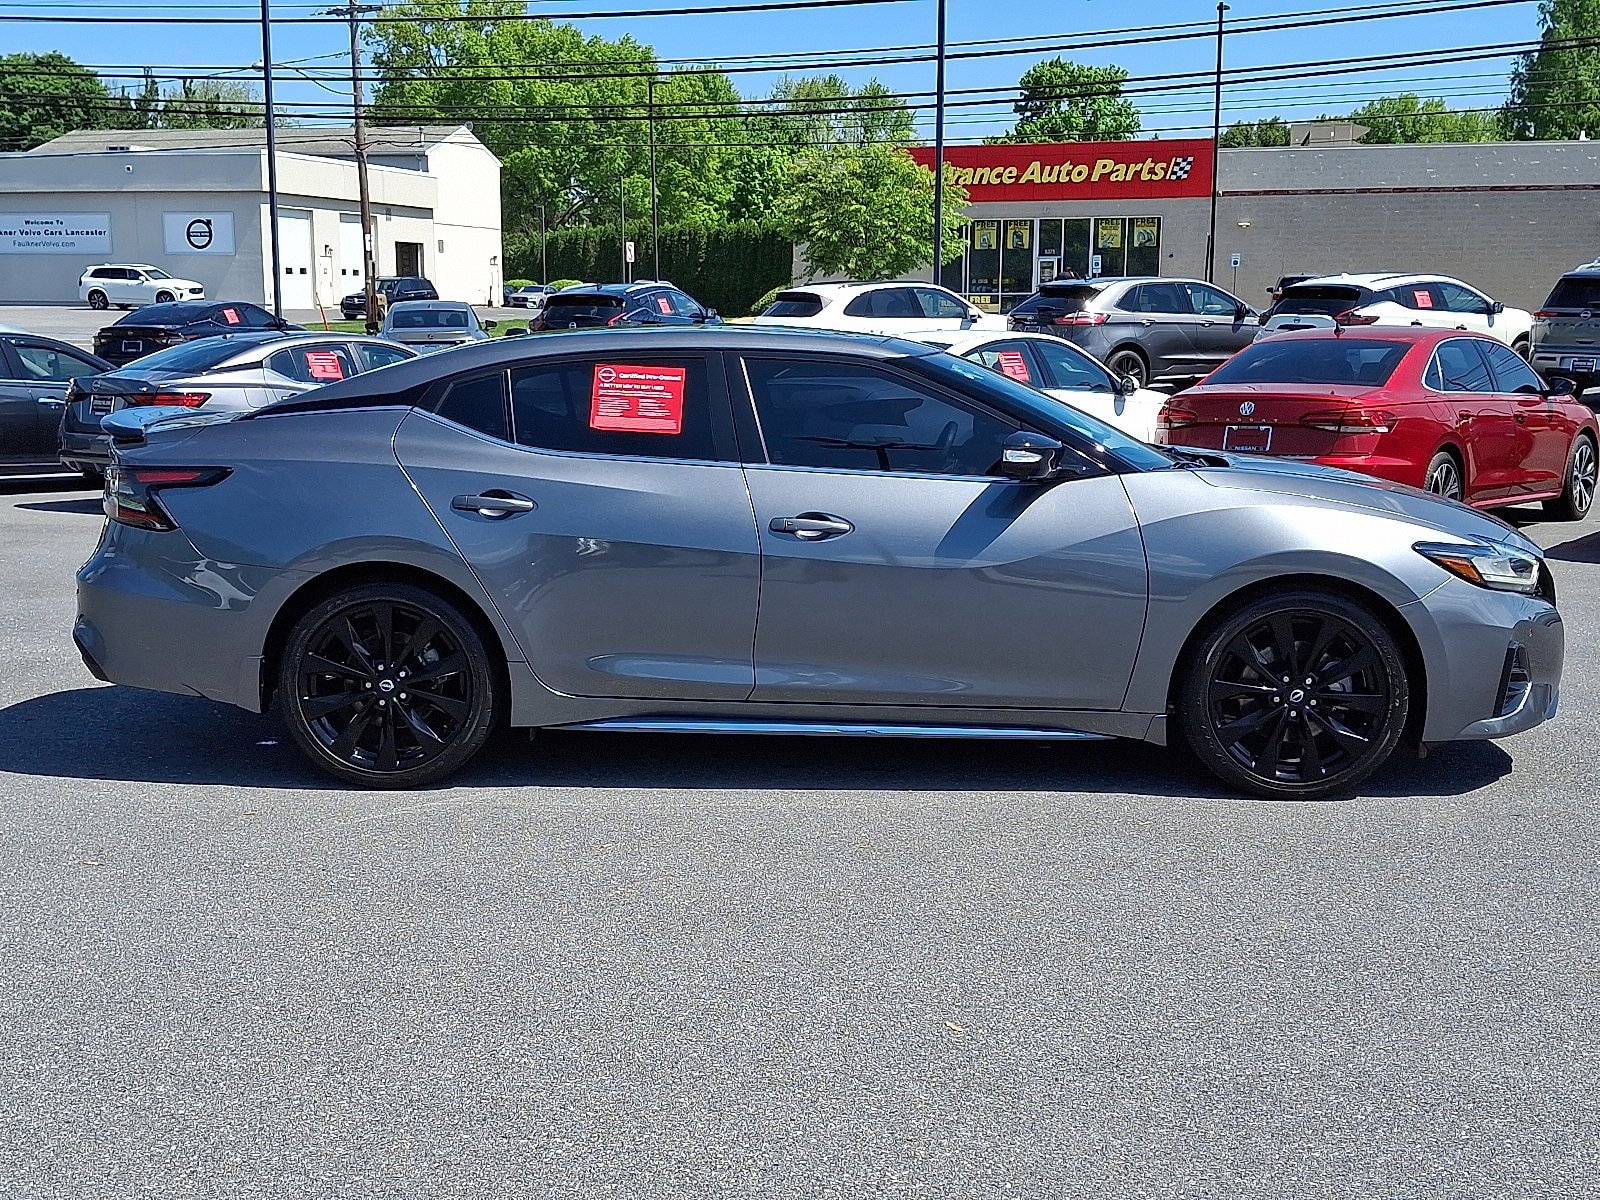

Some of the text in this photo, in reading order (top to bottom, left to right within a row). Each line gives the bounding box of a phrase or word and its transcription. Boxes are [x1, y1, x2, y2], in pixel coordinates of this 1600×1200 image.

[918, 157, 1166, 185] vance Auto Parts
[13, 240, 76, 248] FaulknerVolvo.com
[969, 295, 991, 304] FREE
